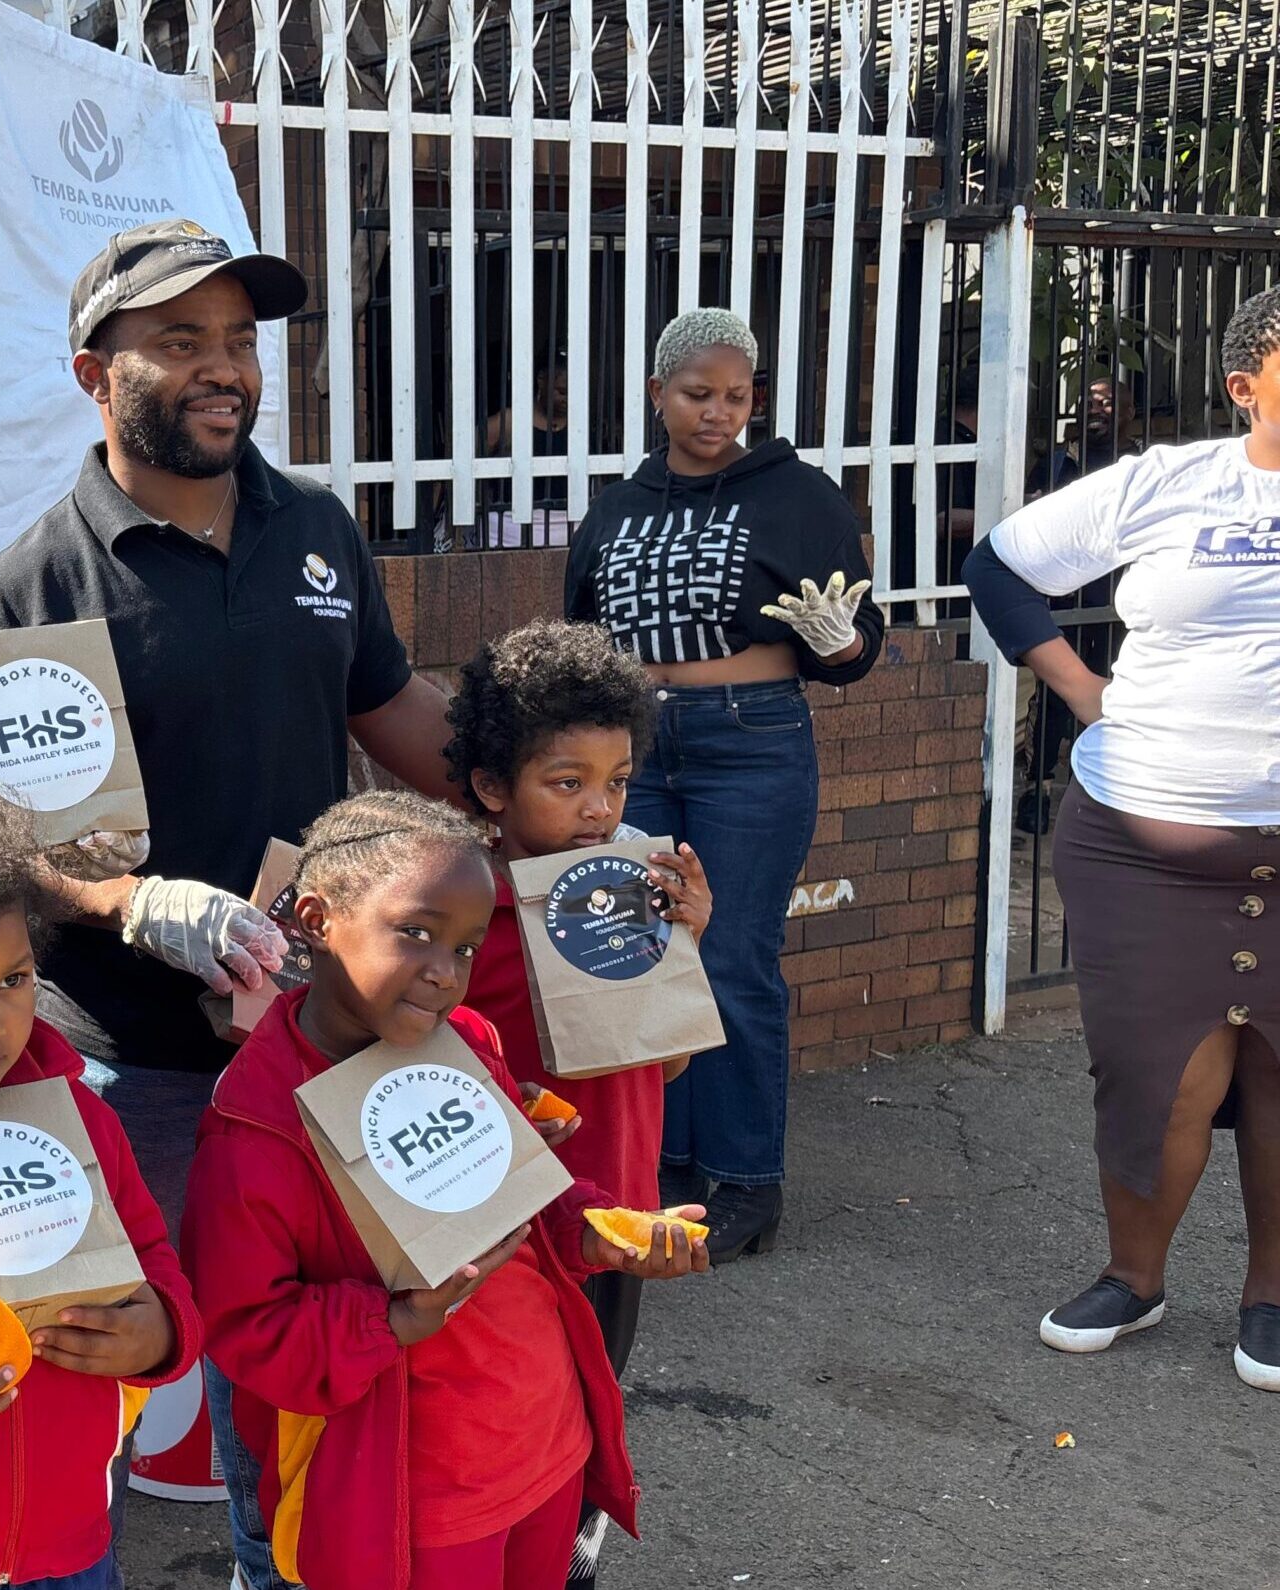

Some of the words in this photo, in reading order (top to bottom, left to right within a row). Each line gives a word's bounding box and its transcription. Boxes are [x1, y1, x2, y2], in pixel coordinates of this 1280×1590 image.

[31, 174, 89, 206] TEMBA
[91, 191, 175, 213] BAVUMA
[294, 596, 326, 606] TEMBA
[0, 667, 33, 687] BOX
[39, 667, 104, 714] PROJECT
[22, 749, 61, 764] HARTLEY
[63, 740, 102, 755] SHELTER
[270, 889, 293, 916] LUN
[547, 882, 569, 928] LUNCH
[568, 862, 597, 883] BOX
[581, 918, 605, 930] TEMBA
[604, 908, 636, 923] BAVUMA
[376, 1078, 402, 1102] BOX
[406, 1071, 482, 1098] PROJECT
[368, 1105, 385, 1160] LUNCH
[387, 1097, 475, 1168] FHS
[405, 1167, 428, 1184] FRIDA
[426, 1145, 460, 1171] HARTLEY
[460, 1122, 495, 1149] SHELTER
[34, 1189, 77, 1207] SHELTER
[24, 1229, 35, 1239] BY
[38, 1216, 79, 1234] ADDHOPE
